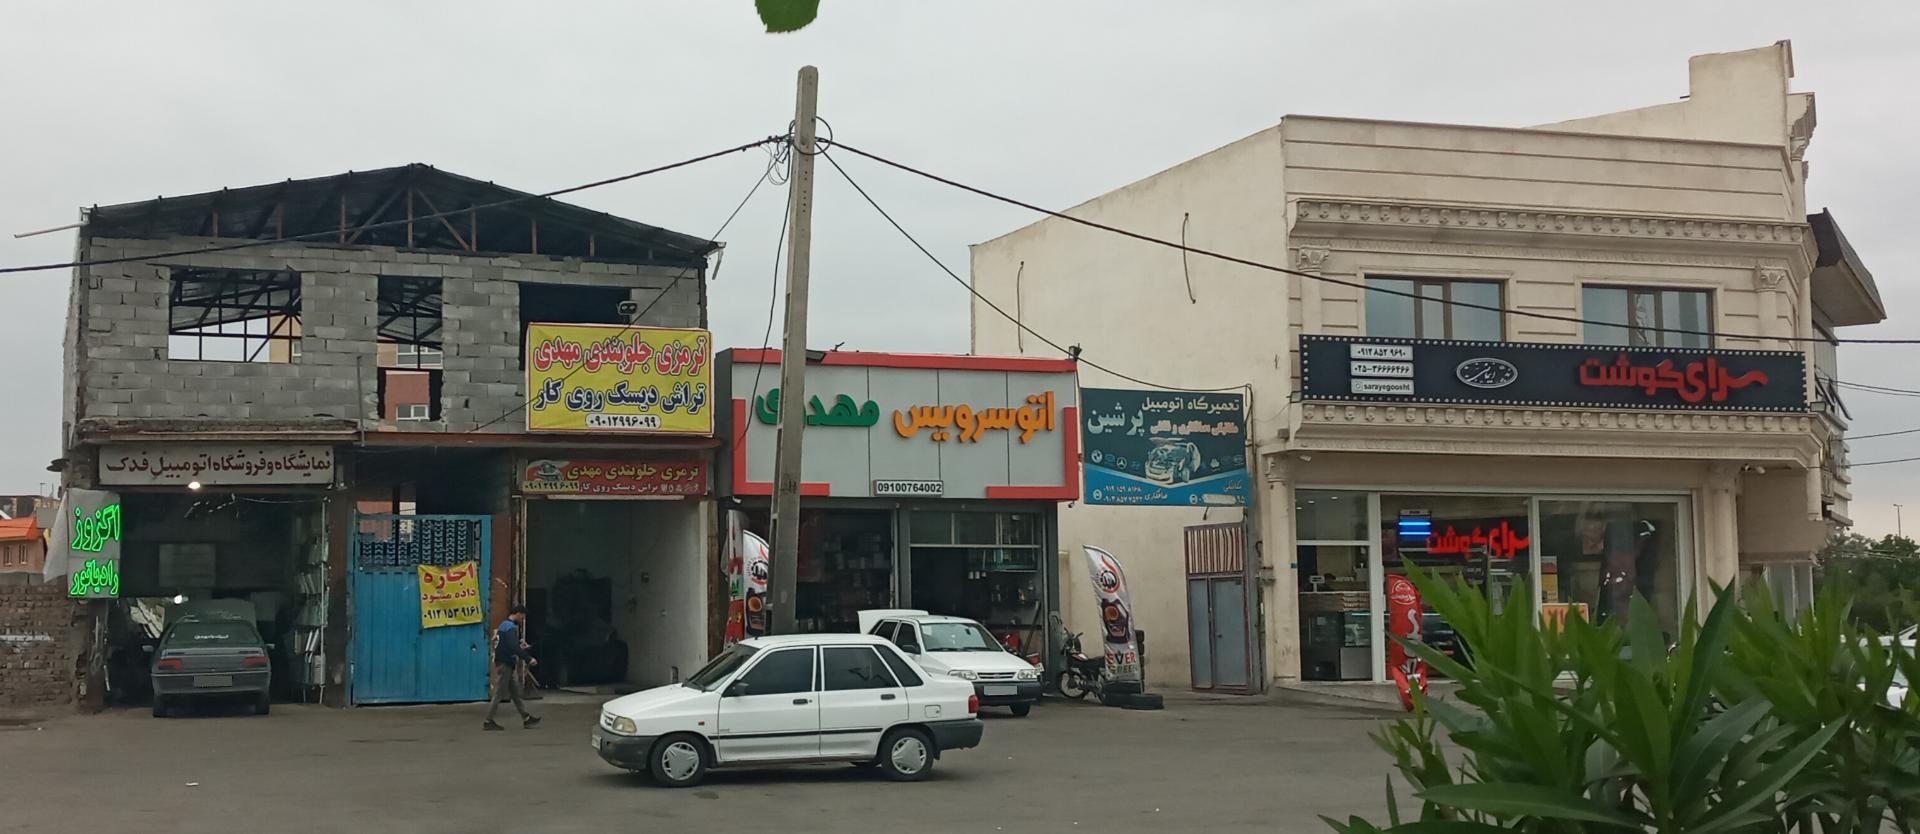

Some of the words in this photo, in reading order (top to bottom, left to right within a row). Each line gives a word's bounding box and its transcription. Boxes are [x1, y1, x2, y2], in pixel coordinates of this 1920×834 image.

[534, 337, 581, 370] مهدی
[584, 333, 653, 373] جلوبندی
[656, 336, 706, 374] ترمزی
[1579, 353, 1684, 396] گوشت
[1678, 356, 1768, 402] سرای
[534, 379, 564, 409] کار
[565, 387, 605, 410] روی
[607, 381, 659, 410] دیسک
[662, 382, 706, 414] تراش
[1141, 396, 1184, 413] اتومبیل
[1187, 396, 1240, 415] تعمیرگاه
[590, 415, 657, 428] ۰۹۰۱۲۹۹۶۰۹۹
[893, 390, 1055, 444] اتوسرویس
[106, 451, 149, 472] فدک
[150, 453, 211, 477] اتومبیل
[274, 450, 329, 477] نمایشگاه
[566, 464, 602, 479] مهدی
[877, 482, 942, 493] 09100764002
[70, 559, 119, 595] رادیاتور
[423, 563, 475, 590] اجاره
[454, 588, 477, 598] داده
